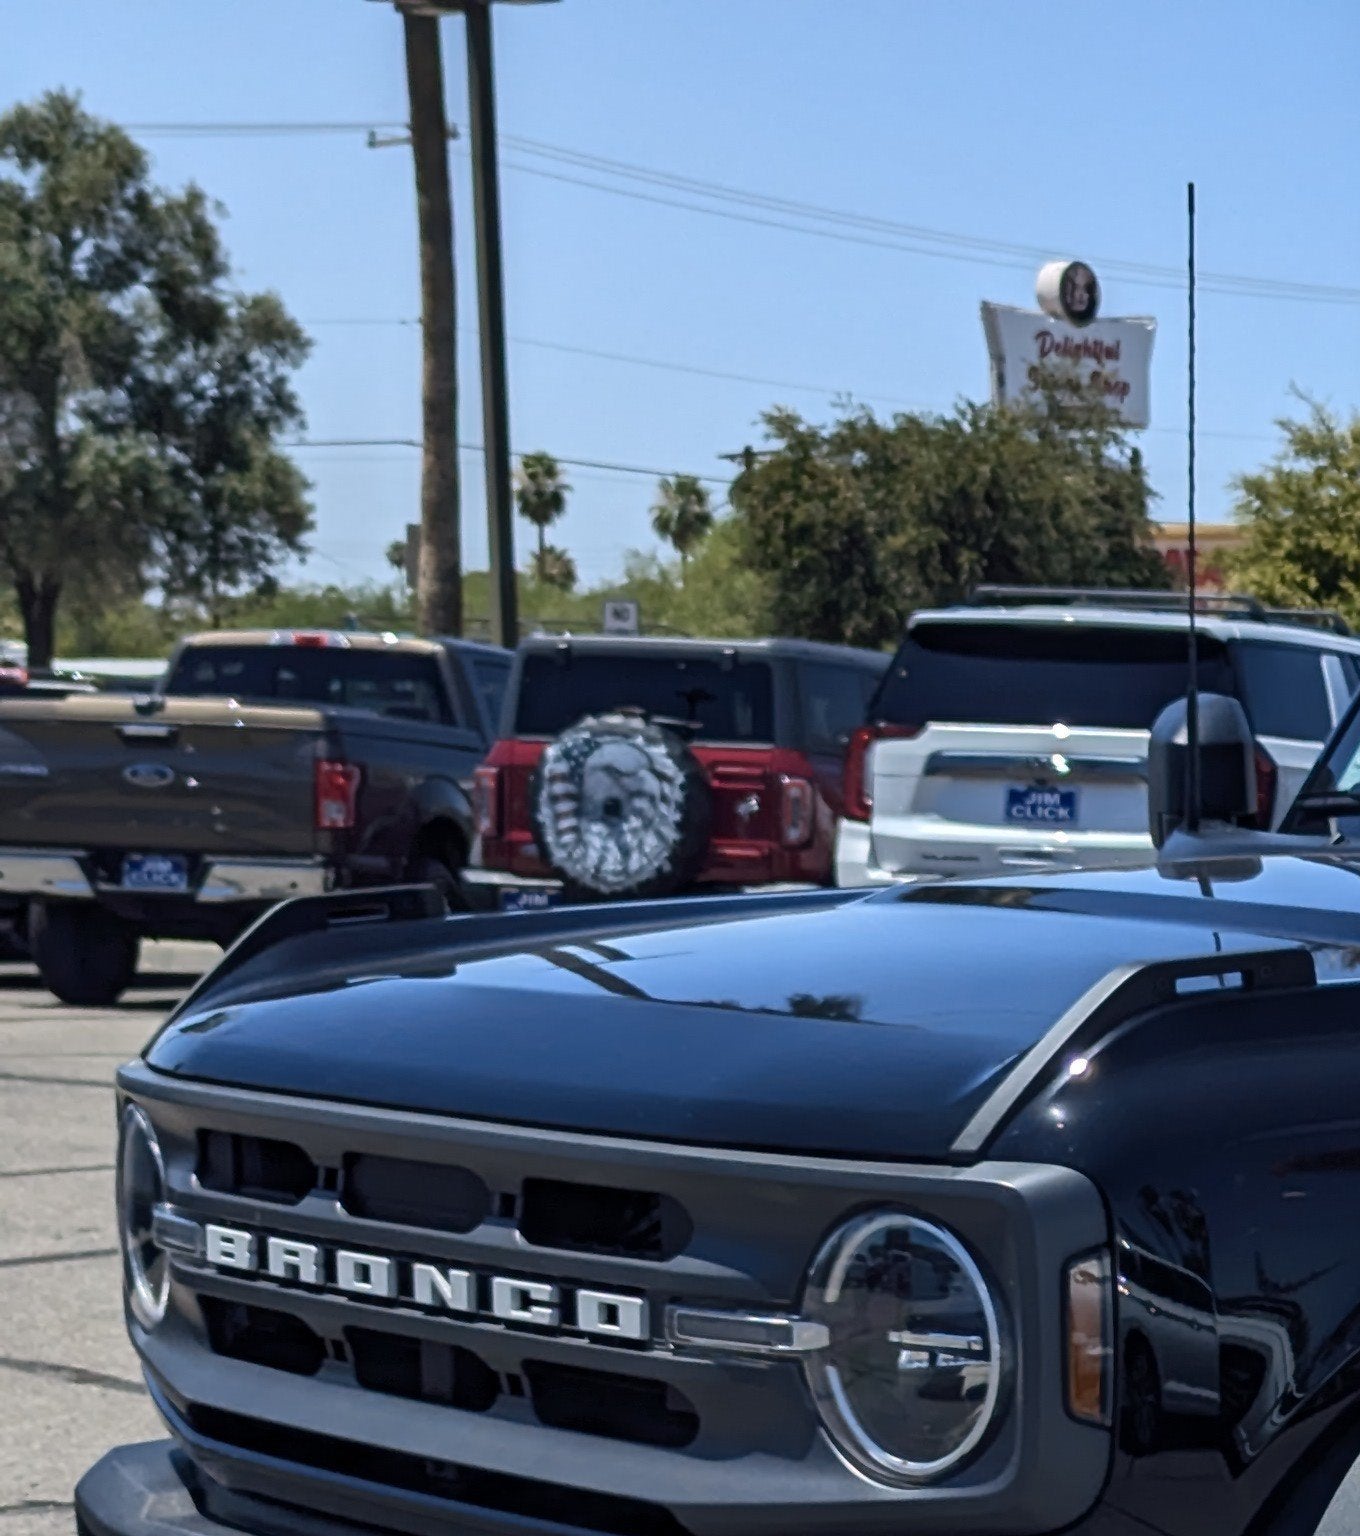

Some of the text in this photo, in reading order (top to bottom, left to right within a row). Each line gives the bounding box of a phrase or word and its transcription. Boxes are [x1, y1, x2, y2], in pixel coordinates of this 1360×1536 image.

[1025, 793, 1061, 806] JIM
[1010, 804, 1070, 819] CLICK
[205, 1222, 649, 1341] BRONCO
